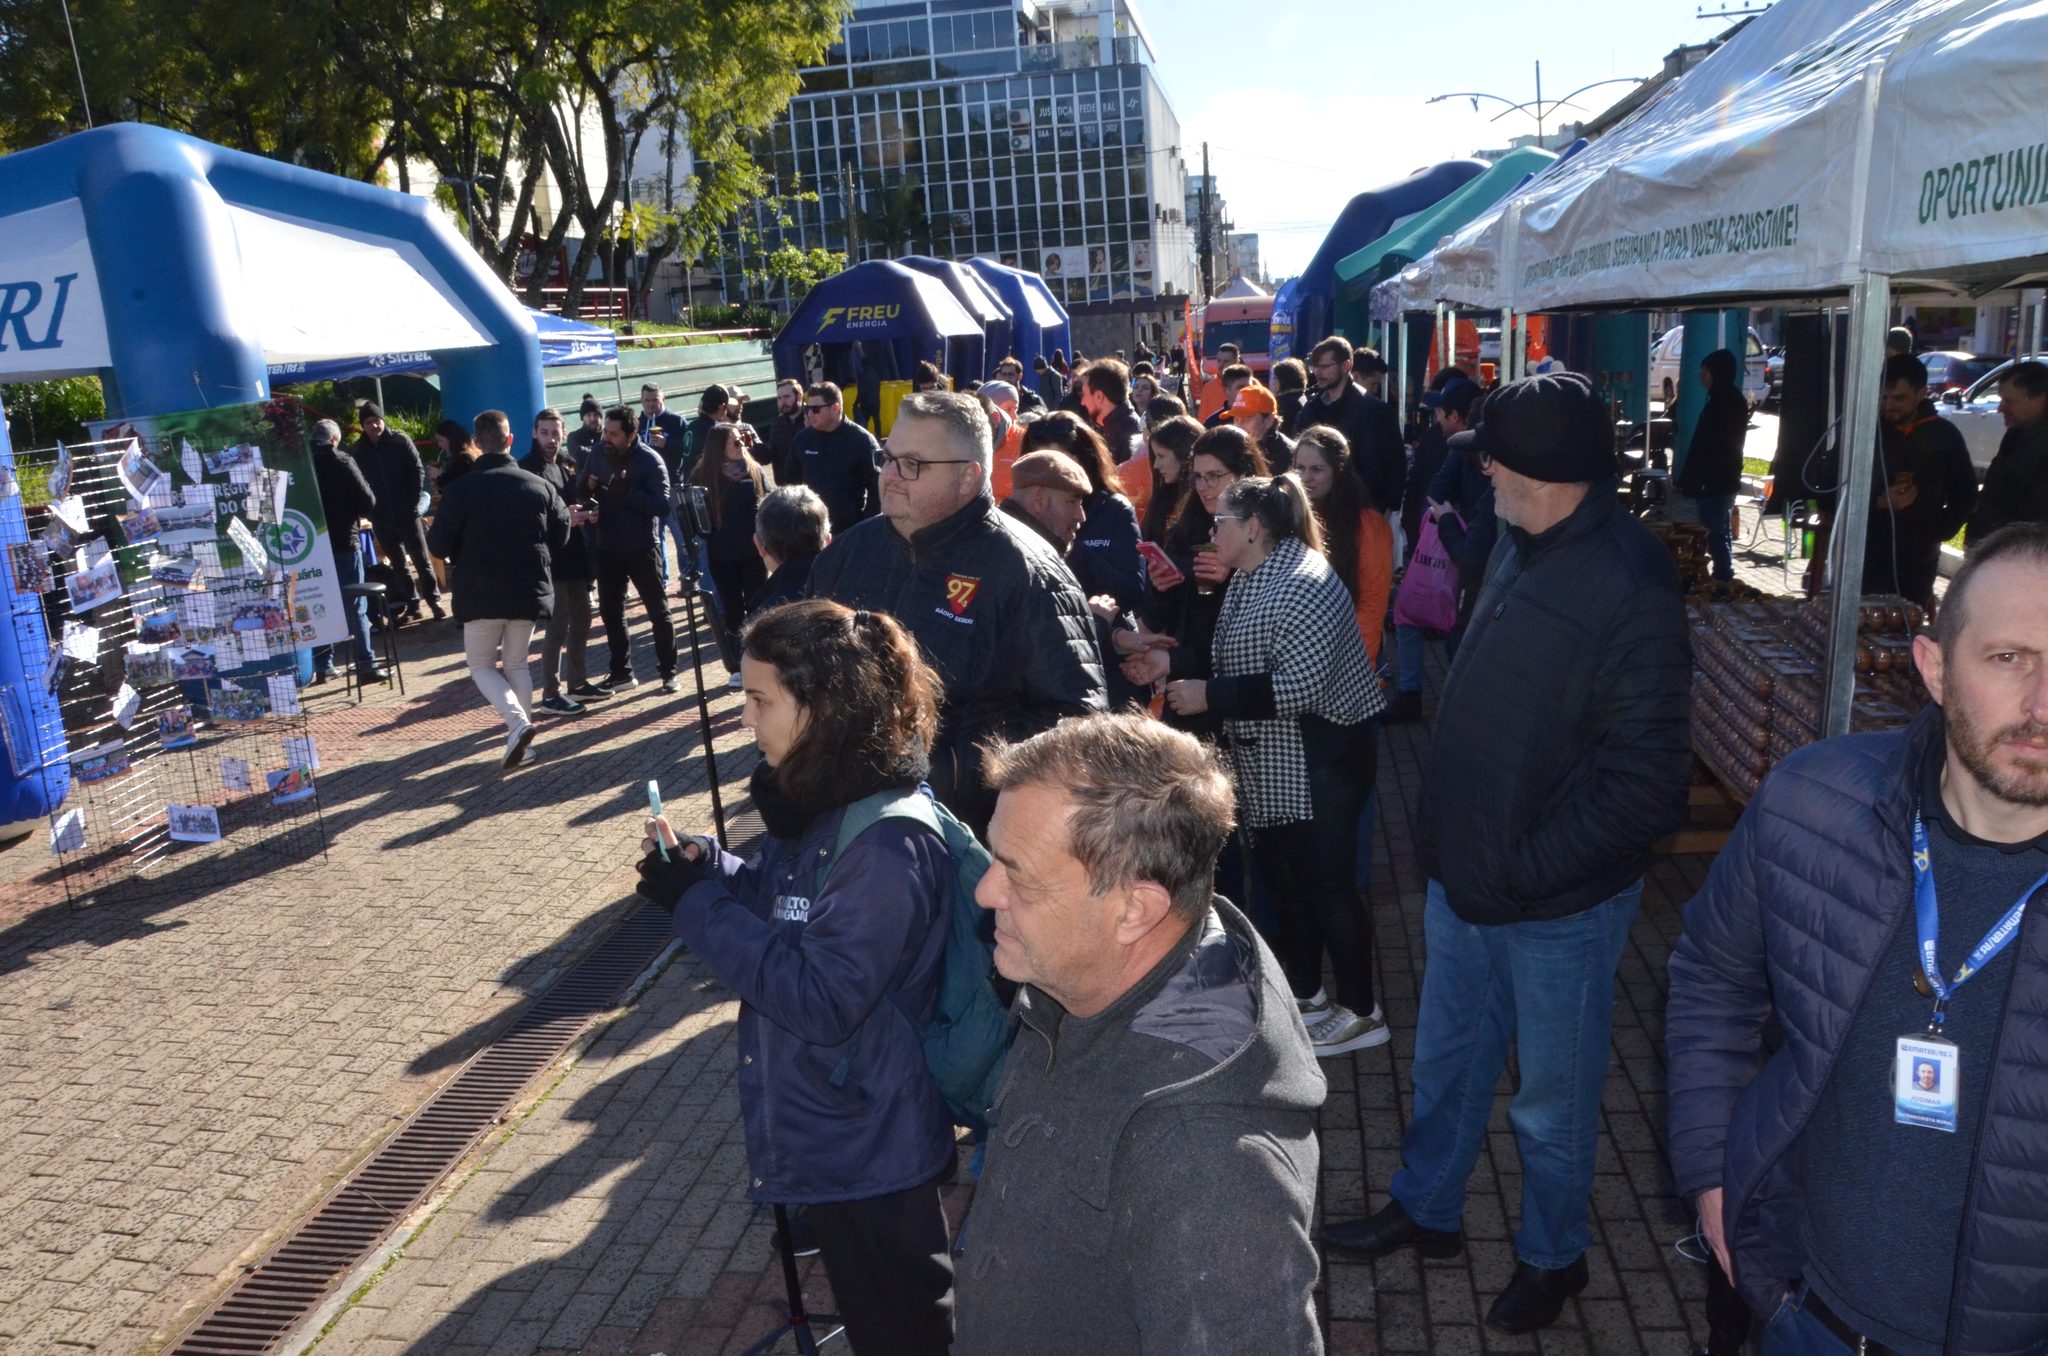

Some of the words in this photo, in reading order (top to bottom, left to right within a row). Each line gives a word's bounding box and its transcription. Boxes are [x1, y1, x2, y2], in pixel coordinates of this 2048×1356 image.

[1039, 105, 1073, 118] JUSTIÇA
[1080, 101, 1116, 114] FEDERAL
[1660, 226, 1689, 262] PARA
[1690, 217, 1725, 259] QUEM
[1727, 203, 1800, 253] CONSOME!
[847, 303, 901, 321] FREU
[846, 320, 888, 329] ENERGIA
[946, 579, 976, 604] 97
